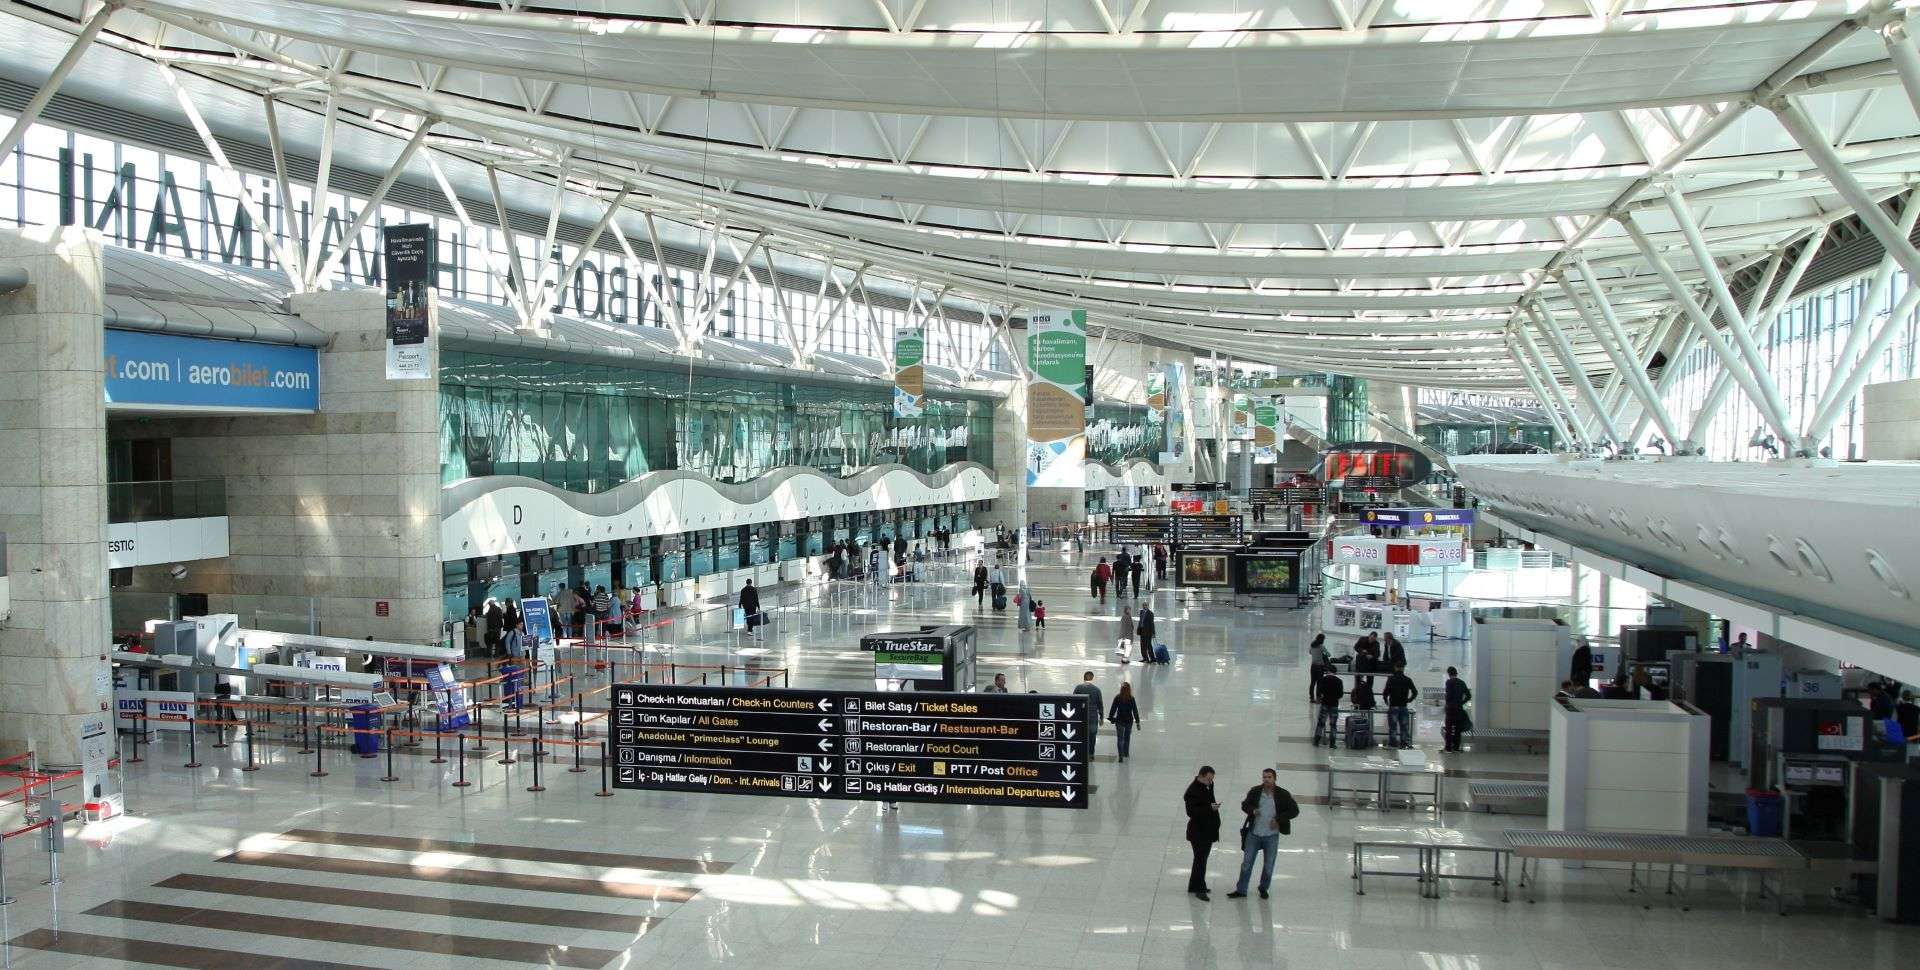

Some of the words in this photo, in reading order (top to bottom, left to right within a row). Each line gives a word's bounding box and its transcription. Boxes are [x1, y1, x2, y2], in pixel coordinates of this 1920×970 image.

[188, 362, 310, 389] aerobilet.com
[513, 505, 522, 524] D
[1355, 548, 1378, 559] avea
[1438, 548, 1461, 559] avea
[884, 640, 934, 651] TrueStar
[638, 694, 675, 704] Check-in
[678, 696, 724, 706] Kontuarları
[732, 698, 771, 707] Check-in
[774, 699, 814, 709] Counters
[865, 702, 885, 710] Bilet
[888, 702, 912, 713] Satış
[920, 703, 948, 712] Ticket
[951, 704, 977, 713] Sales
[638, 714, 657, 722] Tüm
[660, 715, 691, 725] Kapılar
[699, 716, 709, 724] All
[712, 717, 738, 726] Gates
[862, 722, 931, 732] Restoran-Bar
[940, 724, 1018, 734] Restaurant-Bar
[638, 732, 685, 741] AnadoluJet
[690, 734, 744, 743] "primeclass"
[747, 737, 778, 747] Lounge
[866, 742, 918, 752] Restoranlar
[927, 744, 950, 753] Food
[953, 745, 978, 754] Court
[639, 752, 676, 763] Danışma
[684, 754, 731, 764] Information
[866, 762, 889, 773] Çıkış
[899, 763, 915, 772] Exit
[951, 764, 971, 773] PTT
[981, 766, 1004, 775] Post
[1007, 767, 1038, 776] Office
[639, 770, 645, 782] İç
[652, 772, 664, 783] Dış
[666, 773, 687, 782] Hatlar
[689, 774, 707, 785] Geliş
[714, 776, 733, 784] Dom.
[740, 777, 750, 785] Int.
[752, 778, 780, 787] Arrivals
[866, 782, 881, 793] Dış
[884, 782, 911, 791] Hatlar
[914, 784, 938, 795] Gidiş
[947, 785, 1004, 795] International
[1007, 787, 1060, 798] Departures
